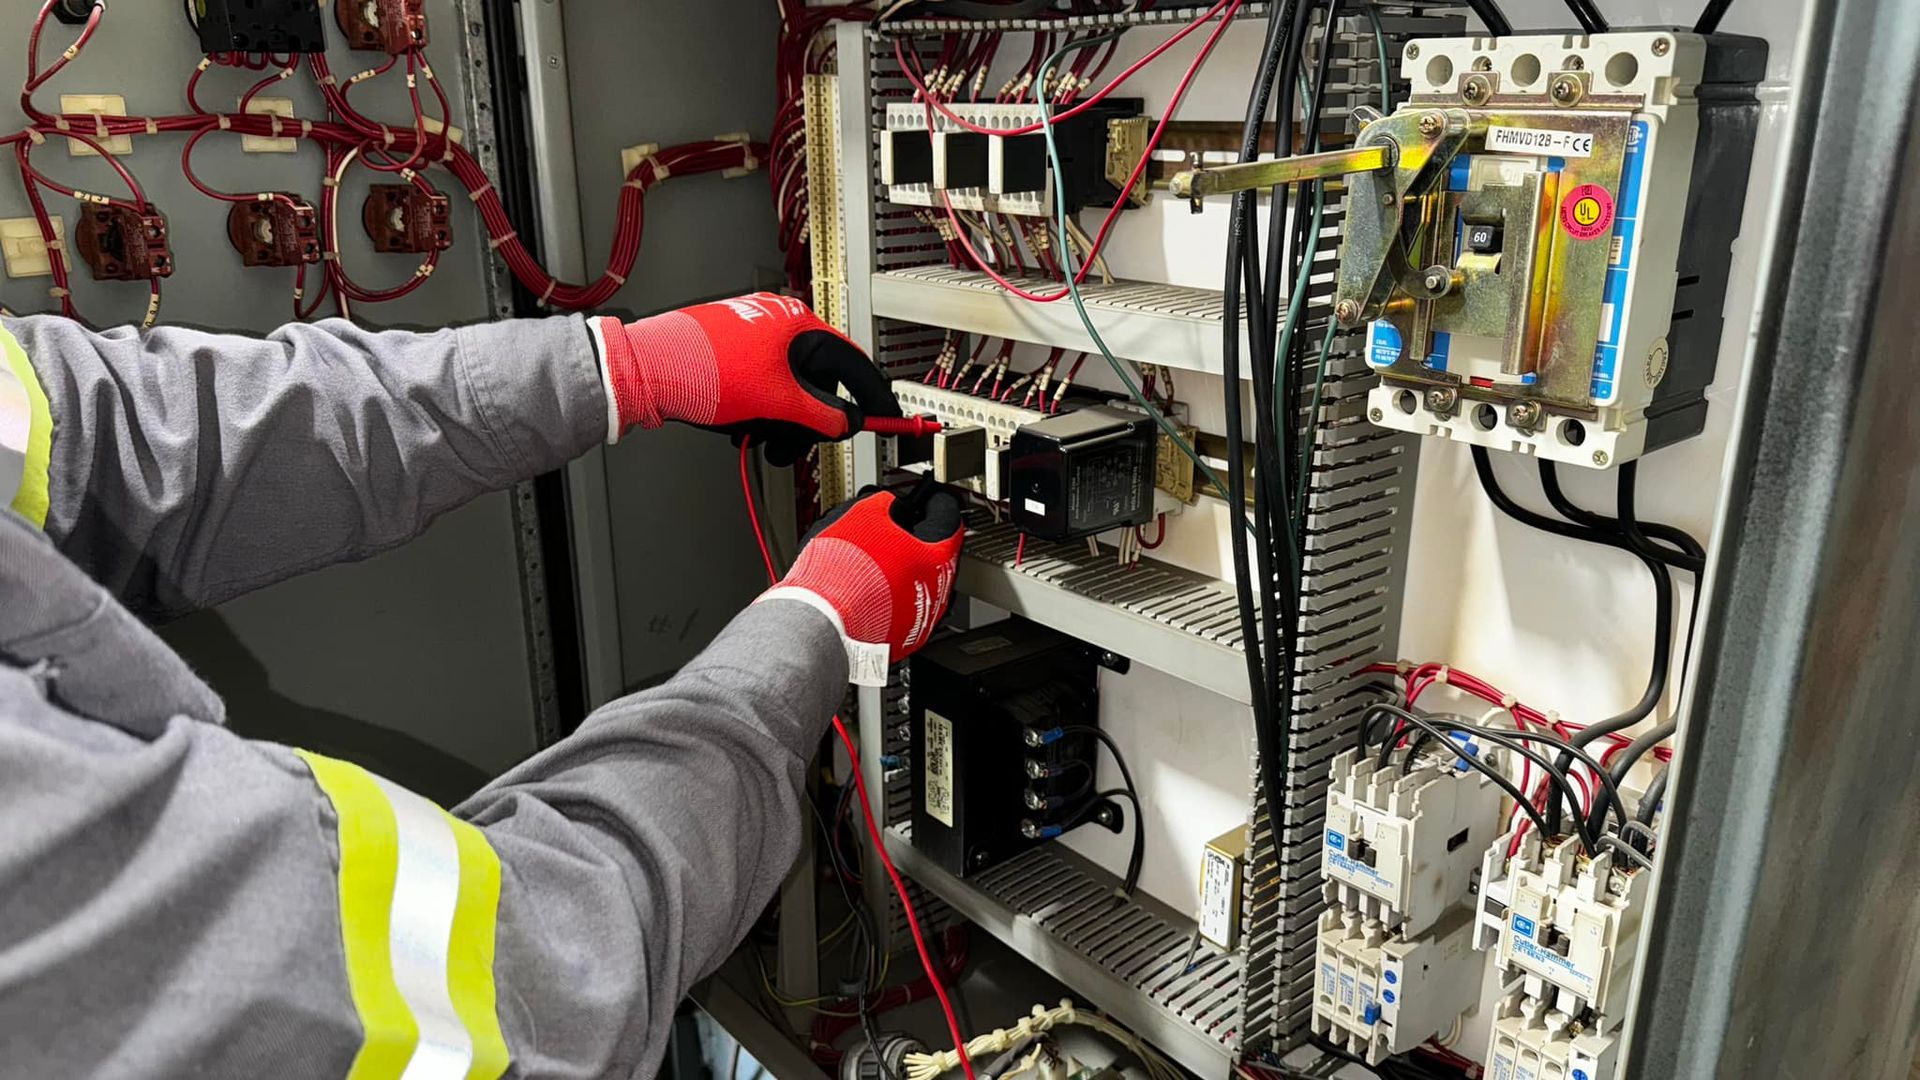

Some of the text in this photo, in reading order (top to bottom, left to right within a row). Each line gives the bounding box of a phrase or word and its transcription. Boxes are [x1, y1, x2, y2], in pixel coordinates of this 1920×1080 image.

[1572, 138, 1591, 152] CE
[1579, 203, 1594, 221] UL
[1473, 231, 1487, 243] 60
[902, 583, 924, 649] Milwaukee
[1513, 934, 1575, 969] Cutler-Hammer
